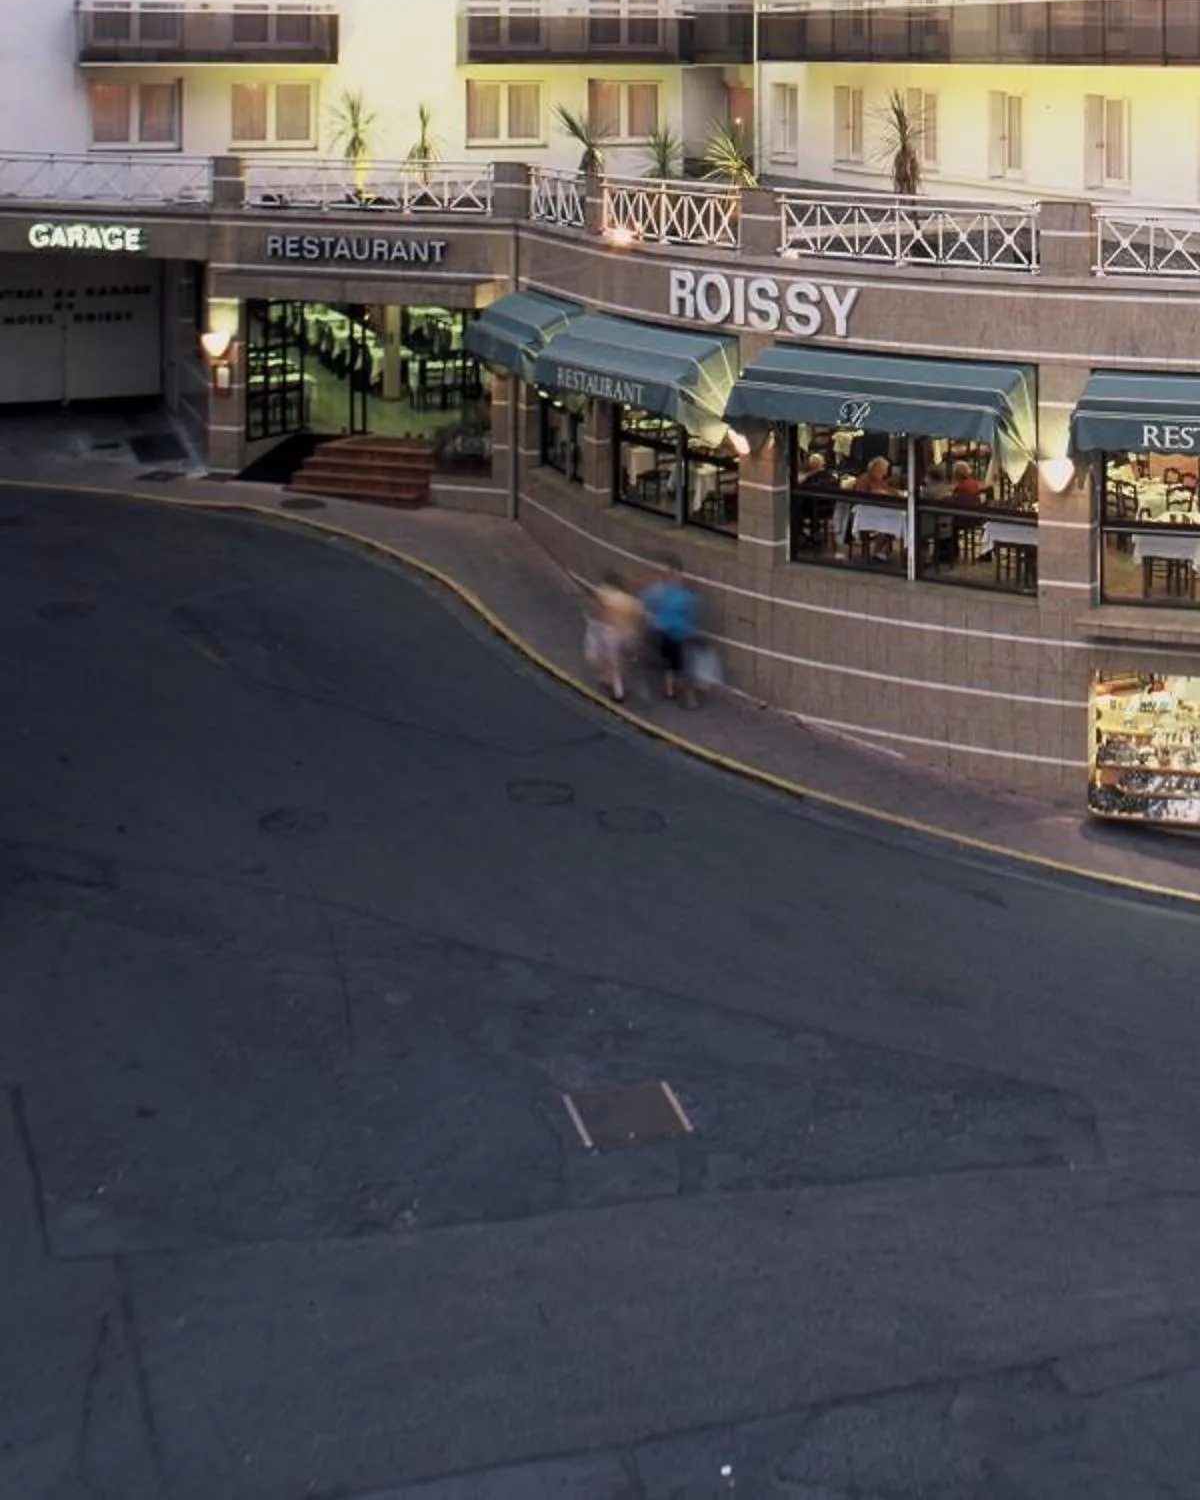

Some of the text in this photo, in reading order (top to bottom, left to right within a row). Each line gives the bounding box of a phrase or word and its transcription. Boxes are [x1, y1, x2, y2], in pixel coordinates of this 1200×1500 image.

[28, 223, 142, 251] GARAGE
[266, 235, 446, 263] RESTAURANT
[669, 269, 860, 338] ROISSY
[557, 366, 644, 405] RESTAURANT
